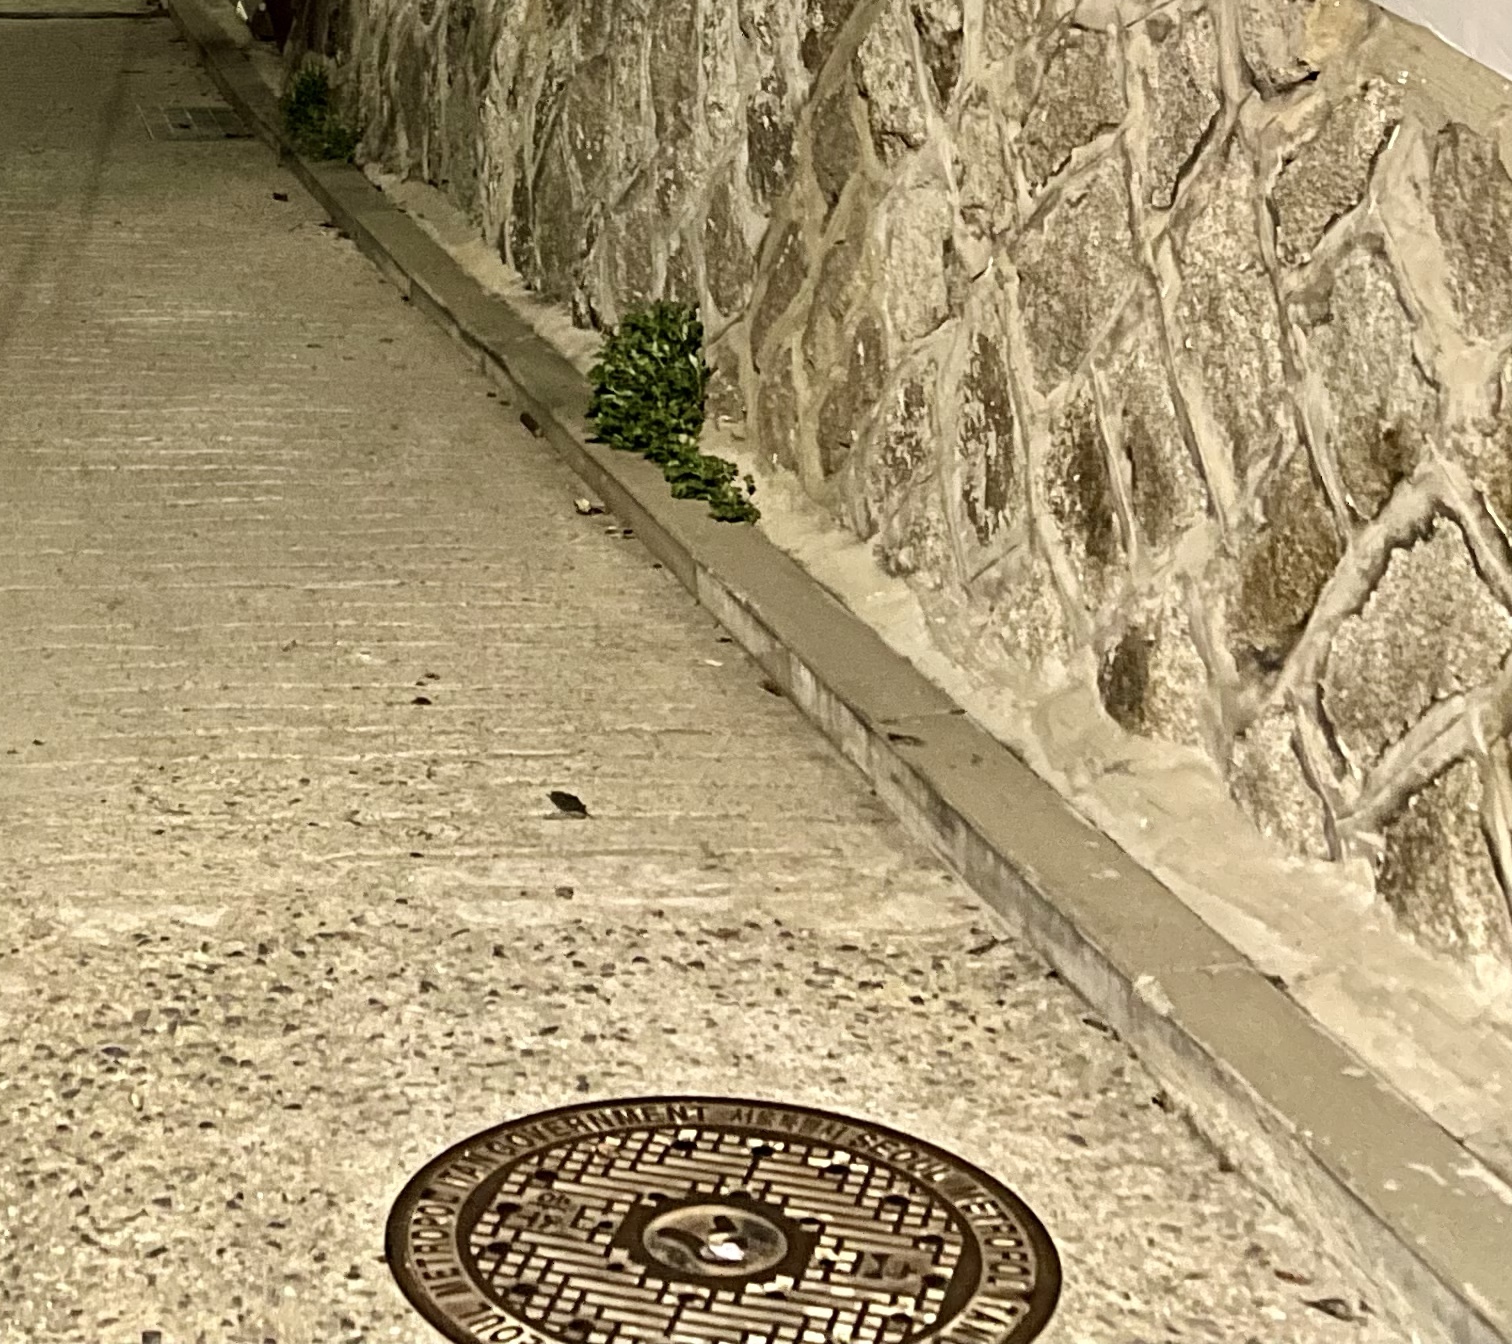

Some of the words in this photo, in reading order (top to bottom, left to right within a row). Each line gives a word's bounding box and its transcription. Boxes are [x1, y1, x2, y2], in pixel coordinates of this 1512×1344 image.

[486, 1105, 705, 1156] GOVERNMENT
[849, 1132, 952, 1182] SEOUL
[458, 1301, 544, 1344] OUL
